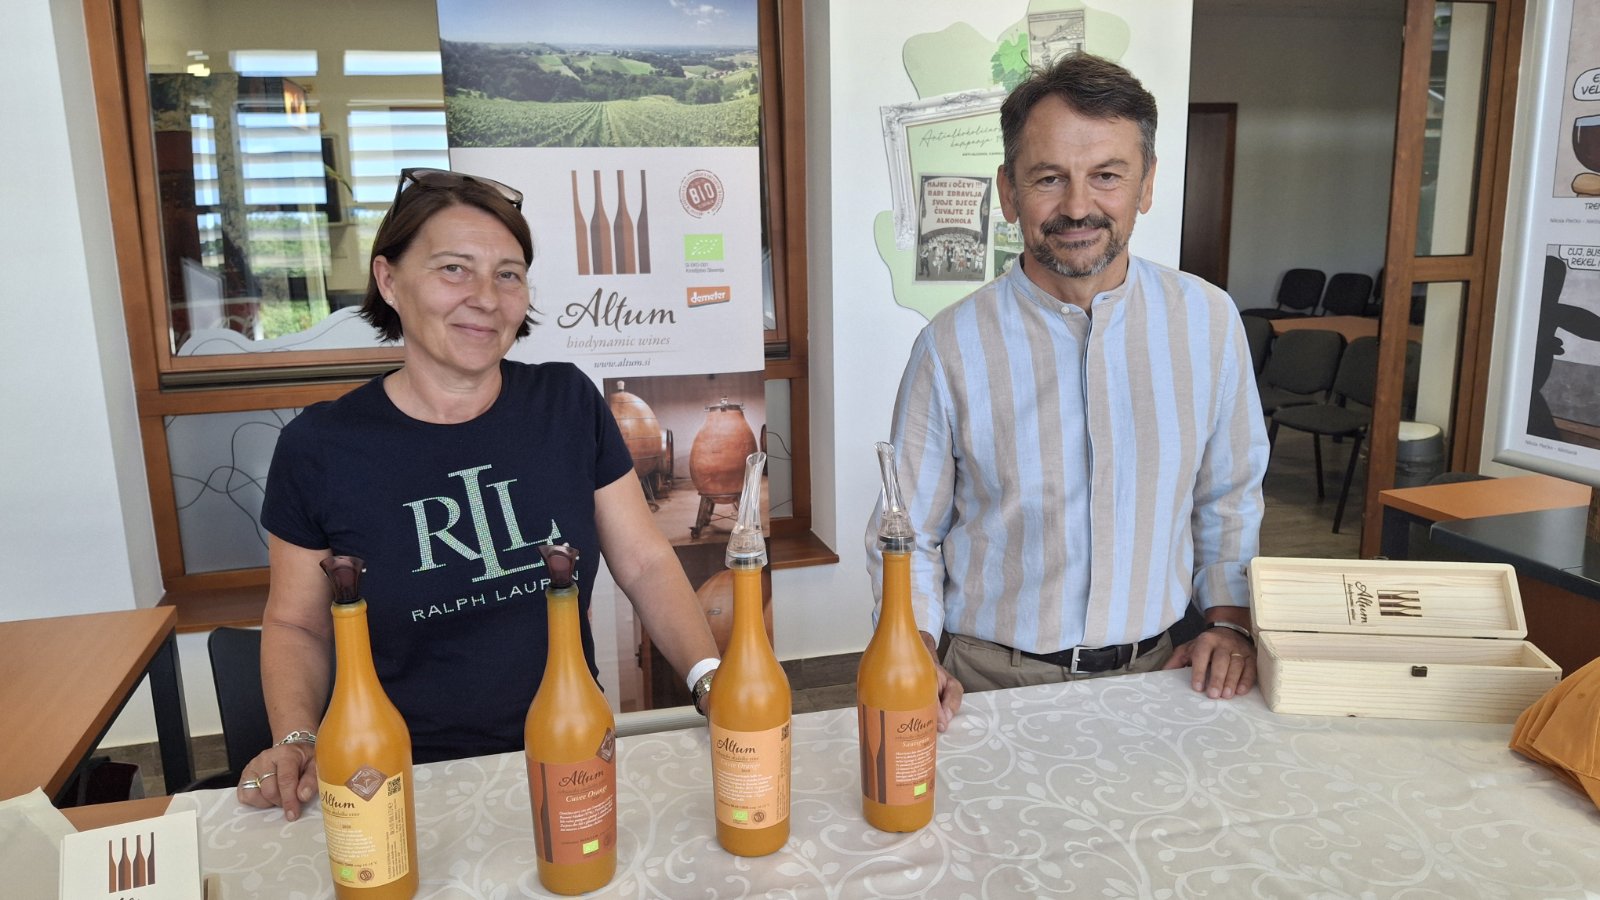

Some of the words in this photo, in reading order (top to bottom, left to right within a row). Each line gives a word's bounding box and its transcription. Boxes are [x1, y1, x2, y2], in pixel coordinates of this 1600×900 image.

[689, 182, 715, 204] BIO
[952, 180, 974, 189] OČEVI
[947, 190, 982, 198] ZDRAVLJA
[934, 206, 963, 215] ČUVAJTE
[936, 217, 972, 225] ALKOHOLA
[1570, 258, 1597, 267] REKEL
[690, 291, 726, 303] demeter
[557, 287, 676, 333] Altum
[566, 335, 635, 352] biodynamic
[638, 334, 671, 346] wines
[594, 358, 651, 369] www.altum.si
[411, 593, 486, 622] RALPH
[1355, 581, 1374, 624] Altum
[717, 737, 756, 756] Altum
[559, 769, 605, 787] Altum
[320, 789, 356, 809] Altum
